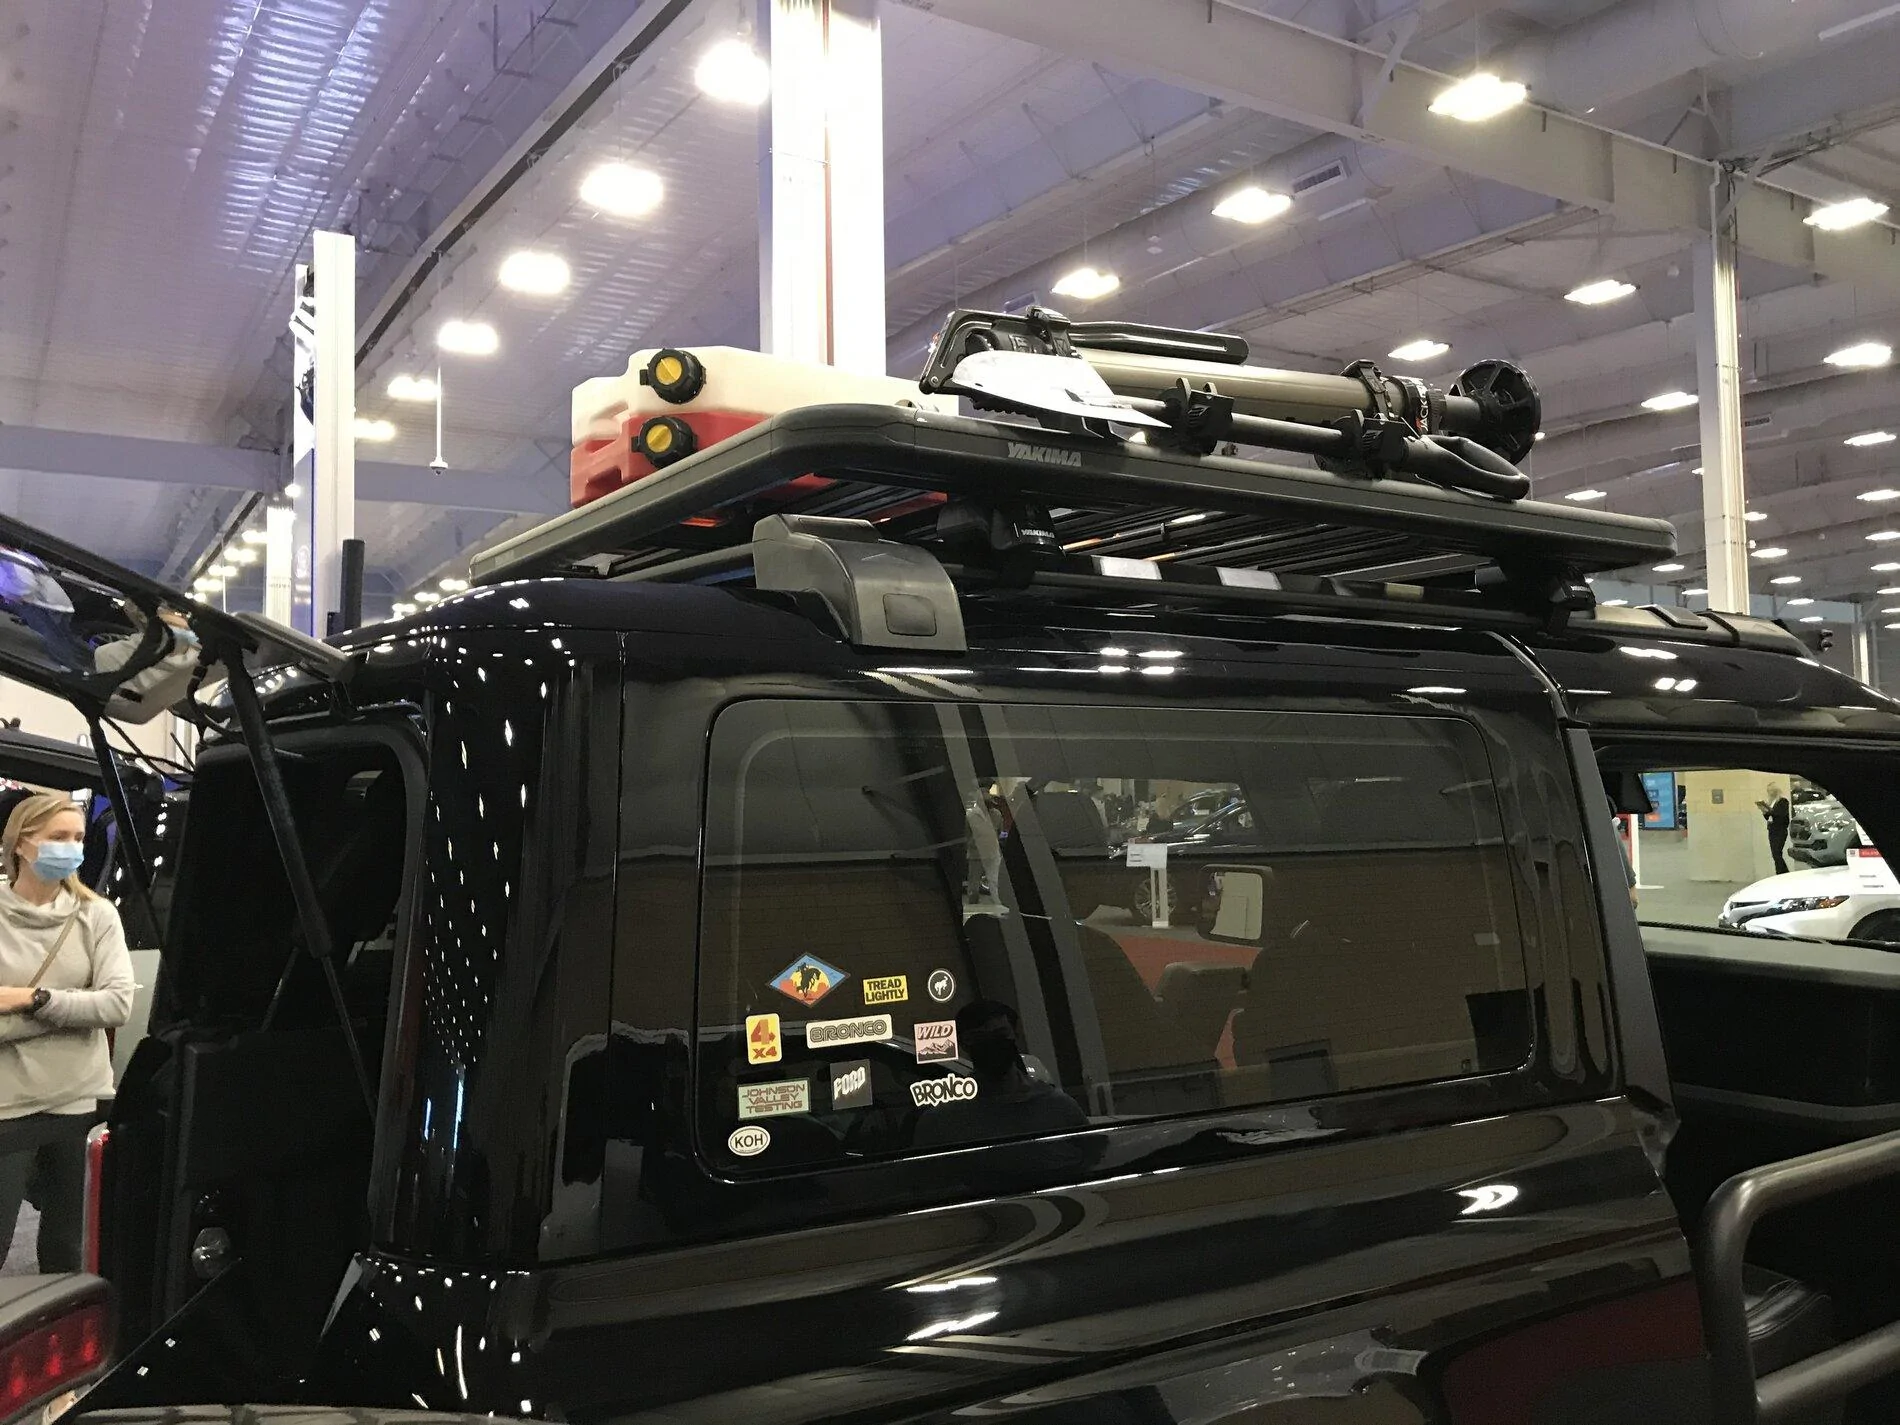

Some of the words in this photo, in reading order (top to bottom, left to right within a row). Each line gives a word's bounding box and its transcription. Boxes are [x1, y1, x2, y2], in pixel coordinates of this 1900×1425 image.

[1007, 441, 1082, 467] YAKIMA
[866, 978, 902, 991] TREAD
[865, 988, 905, 1002] LIGHTLY
[750, 1018, 776, 1045] 4
[809, 1019, 888, 1043] BRONCO
[917, 1024, 953, 1040] WILD
[742, 1083, 805, 1098] JOHNSON
[833, 1066, 866, 1100] FORD
[911, 1075, 976, 1105] BRONCO
[745, 1100, 803, 1114] TESTING
[748, 1093, 799, 1105] VALLEY
[734, 1133, 764, 1149] KOH
